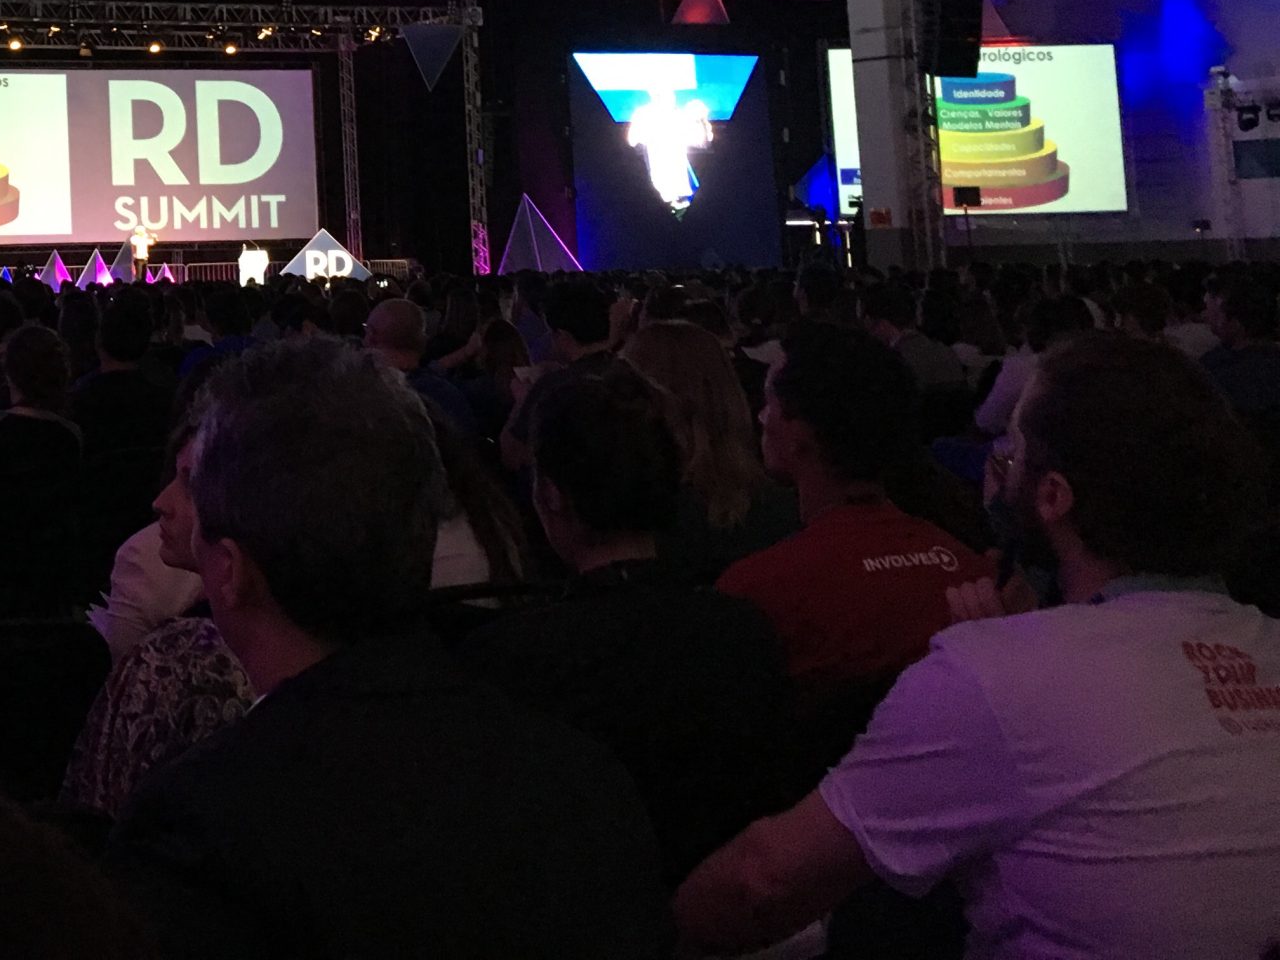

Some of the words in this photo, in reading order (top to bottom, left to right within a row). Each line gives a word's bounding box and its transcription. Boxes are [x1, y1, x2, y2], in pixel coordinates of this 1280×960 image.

[979, 48, 1054, 65] rológicos
[952, 89, 1006, 99] Identidade
[108, 80, 283, 186] RD
[113, 194, 286, 231] SUMMIT
[305, 250, 354, 283] RD
[862, 552, 940, 572] INVOLVES
